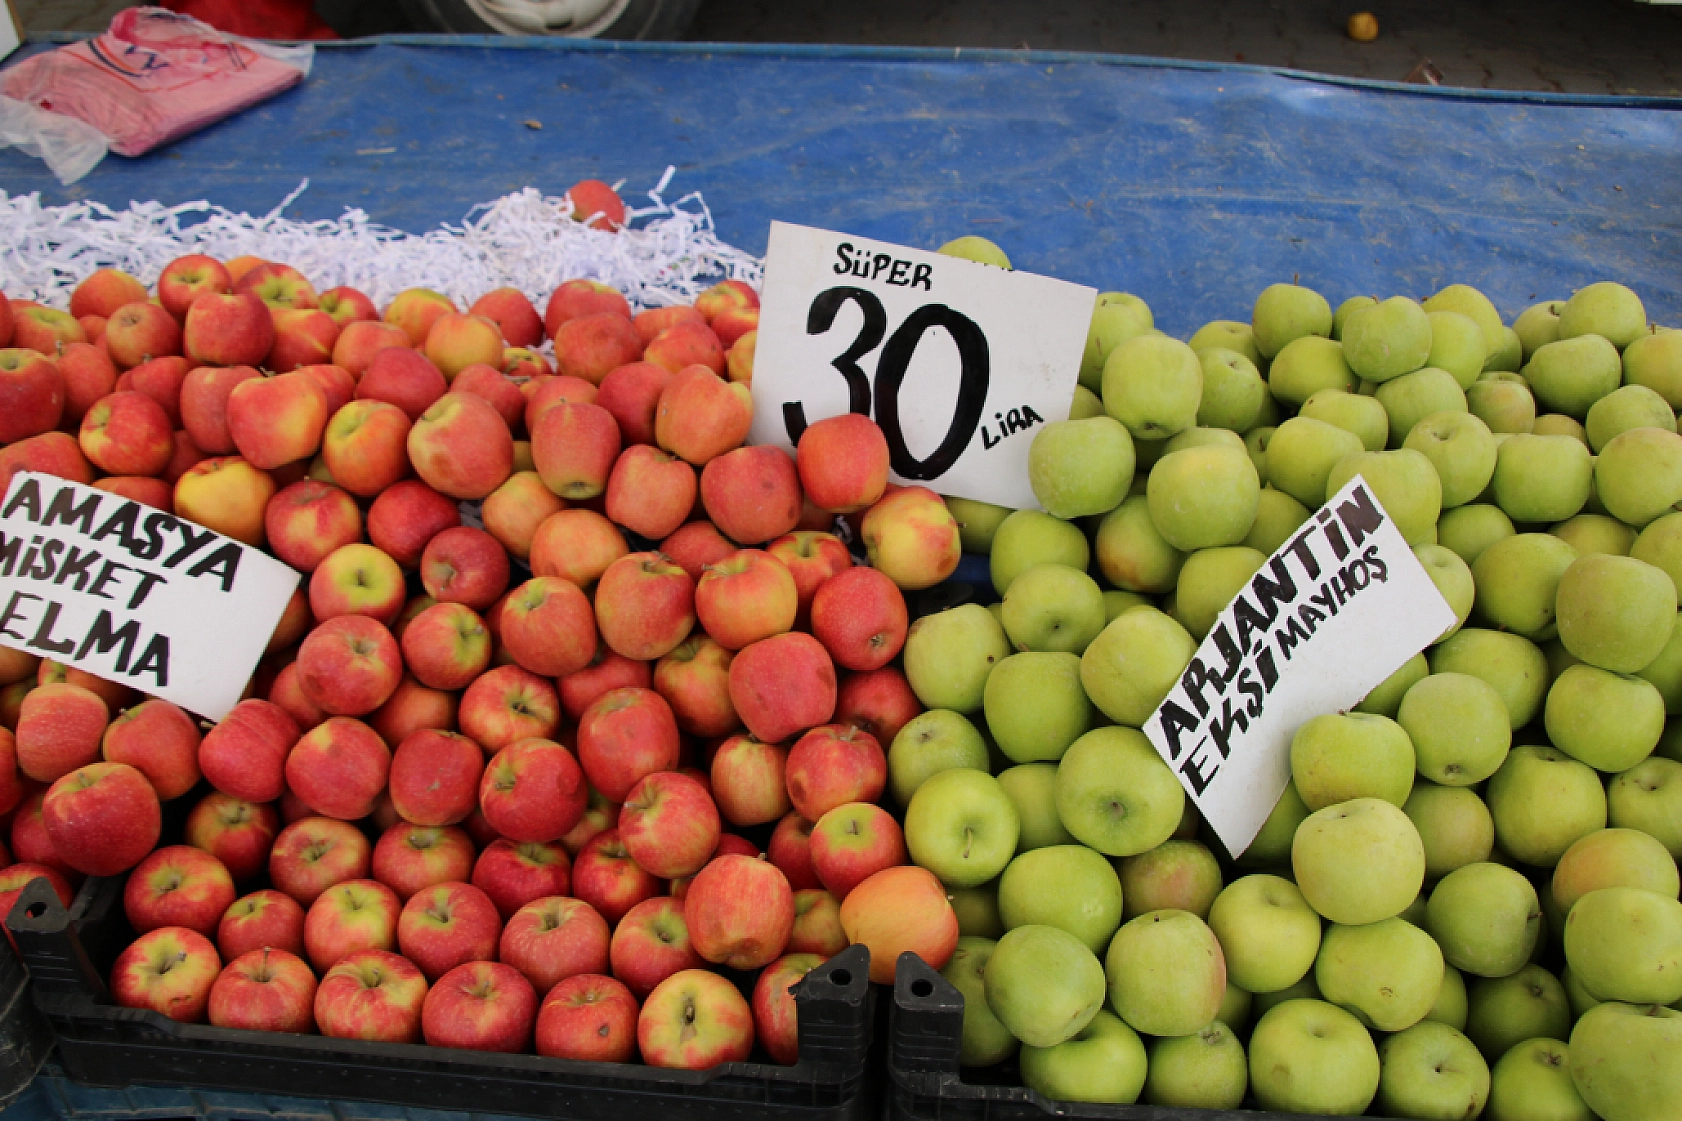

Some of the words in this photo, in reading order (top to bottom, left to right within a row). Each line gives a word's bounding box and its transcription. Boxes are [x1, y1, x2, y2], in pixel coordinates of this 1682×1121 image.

[833, 243, 933, 291] SÜPER
[782, 286, 990, 481] 30
[2, 478, 243, 592] AMASYA
[0, 590, 170, 686] ELMA
